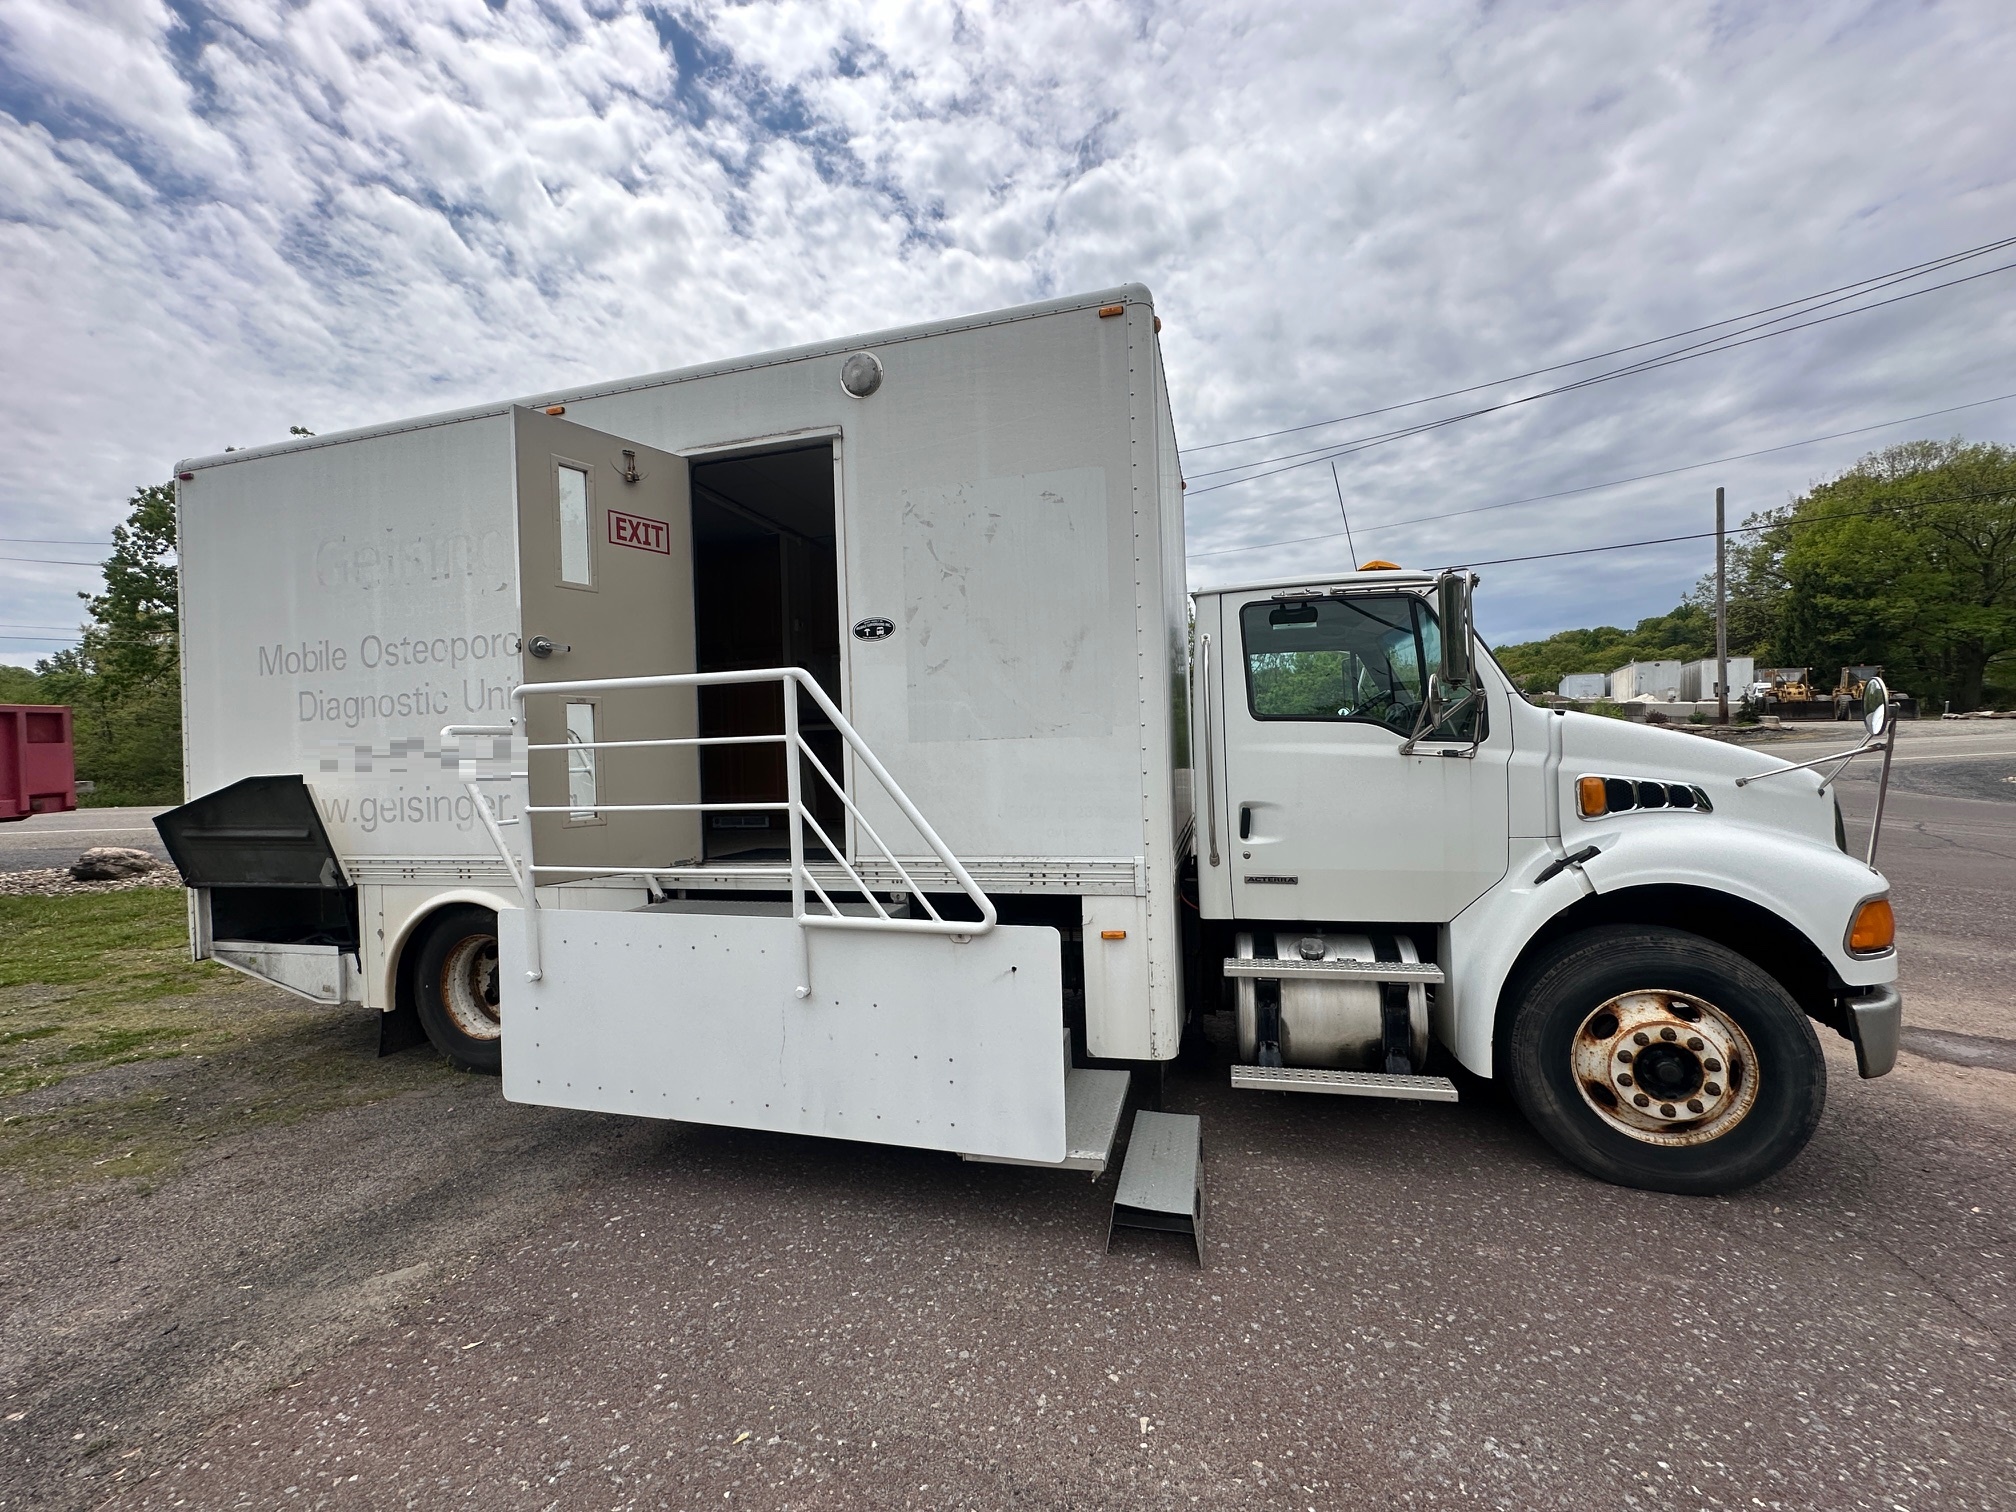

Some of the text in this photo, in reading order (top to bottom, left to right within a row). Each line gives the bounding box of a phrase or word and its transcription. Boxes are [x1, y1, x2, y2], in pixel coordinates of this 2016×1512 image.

[616, 516, 664, 549] EXIT
[258, 640, 347, 676] Mobile
[299, 676, 520, 728] Diagnostic Uni
